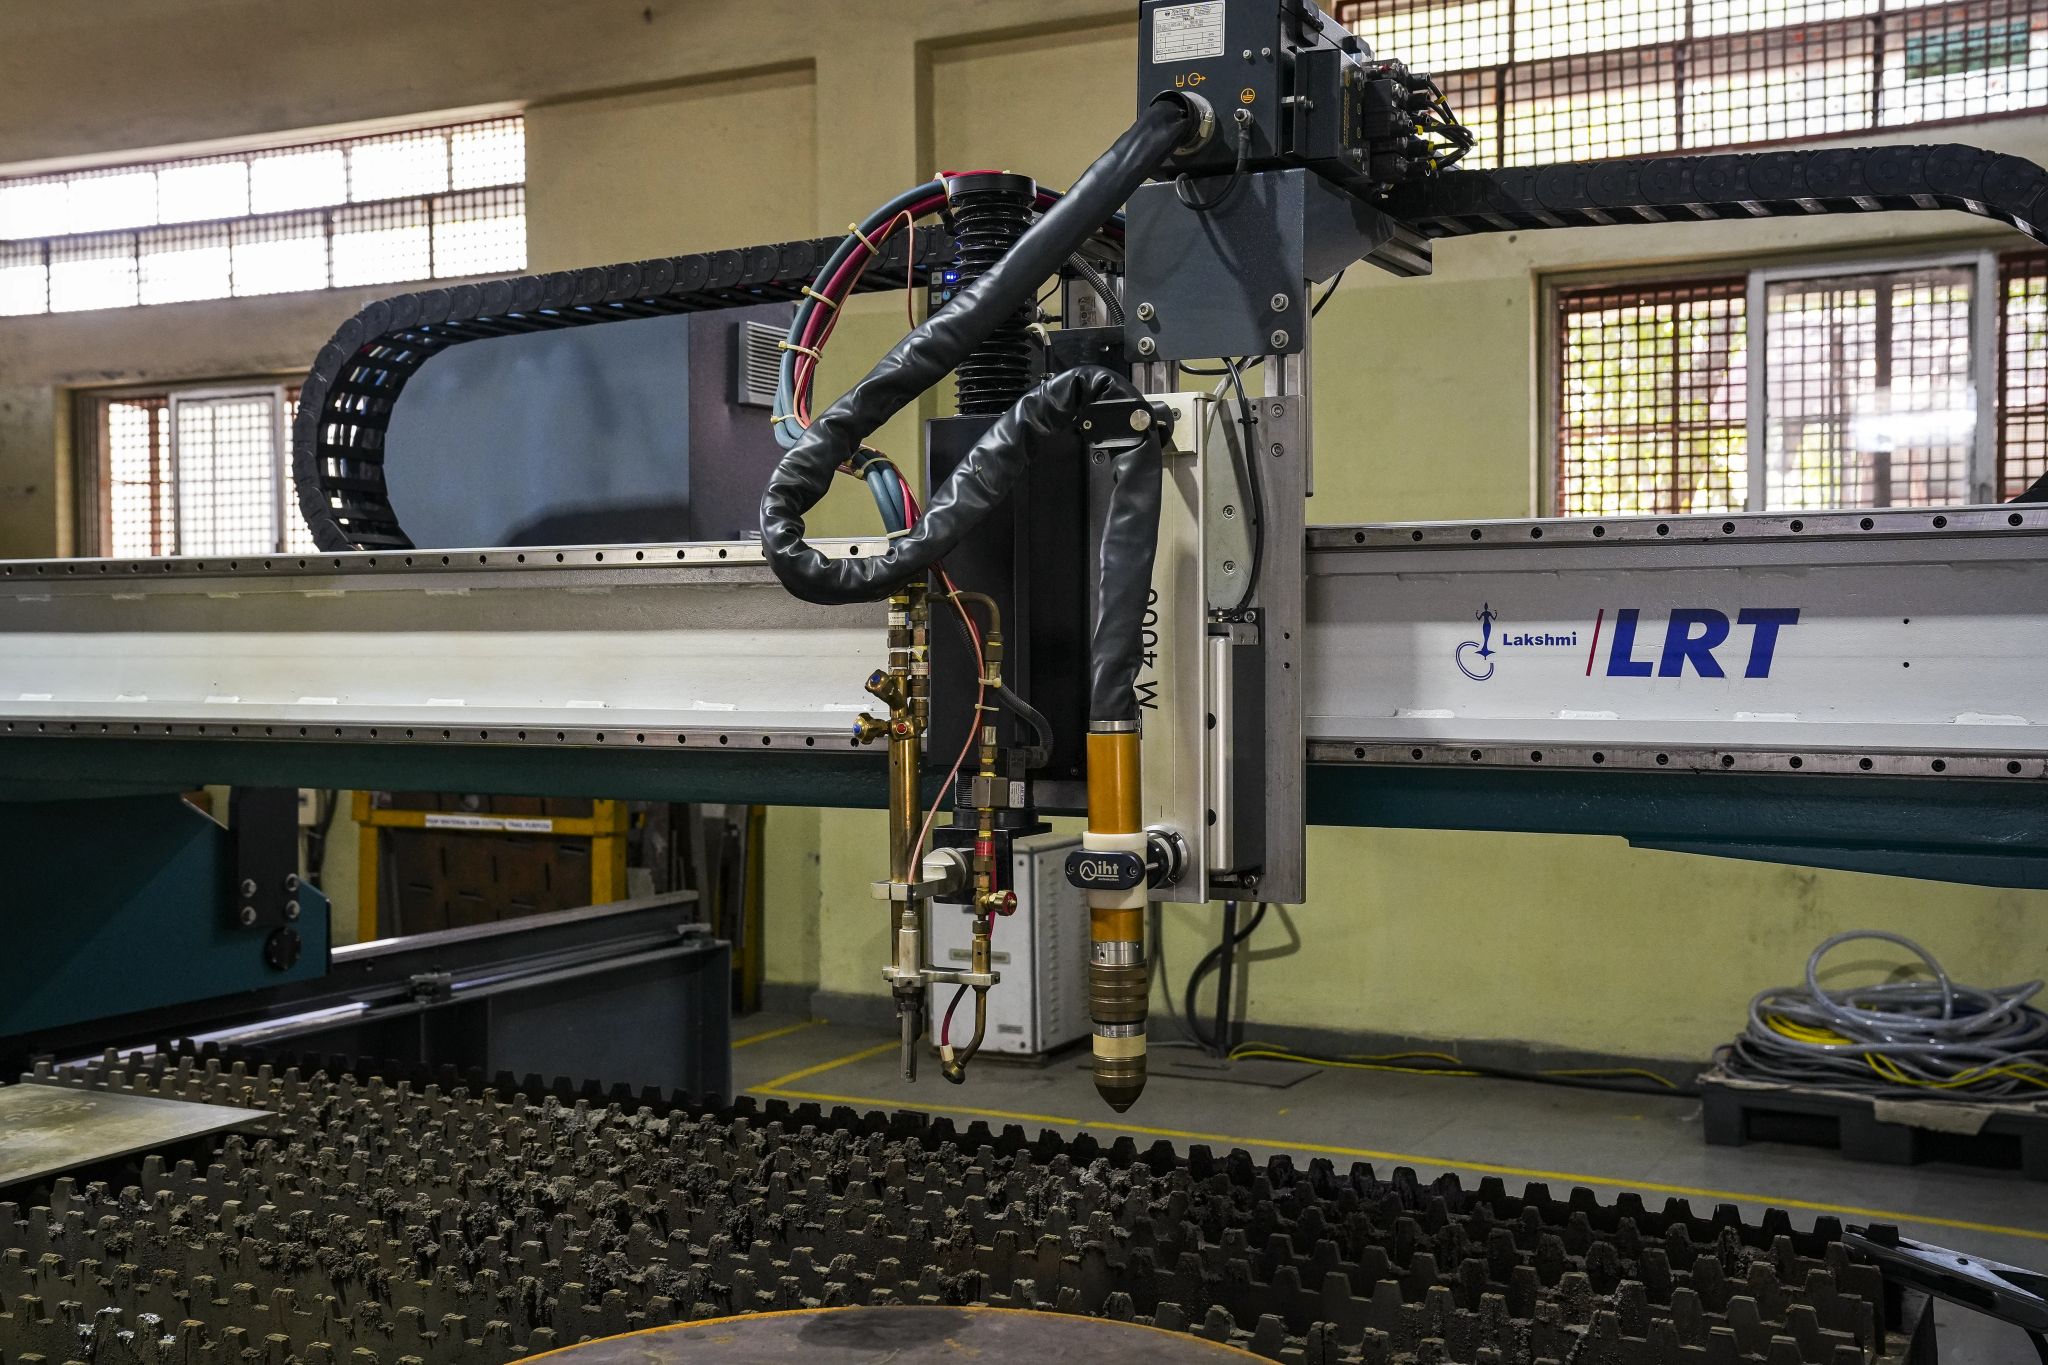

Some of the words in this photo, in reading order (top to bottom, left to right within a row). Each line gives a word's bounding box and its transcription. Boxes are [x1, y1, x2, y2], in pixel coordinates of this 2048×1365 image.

[1502, 631, 1577, 646] Lakshmi
[1606, 608, 1800, 678] LRT
[1134, 680, 1158, 709] M
[1098, 860, 1119, 875] iht
